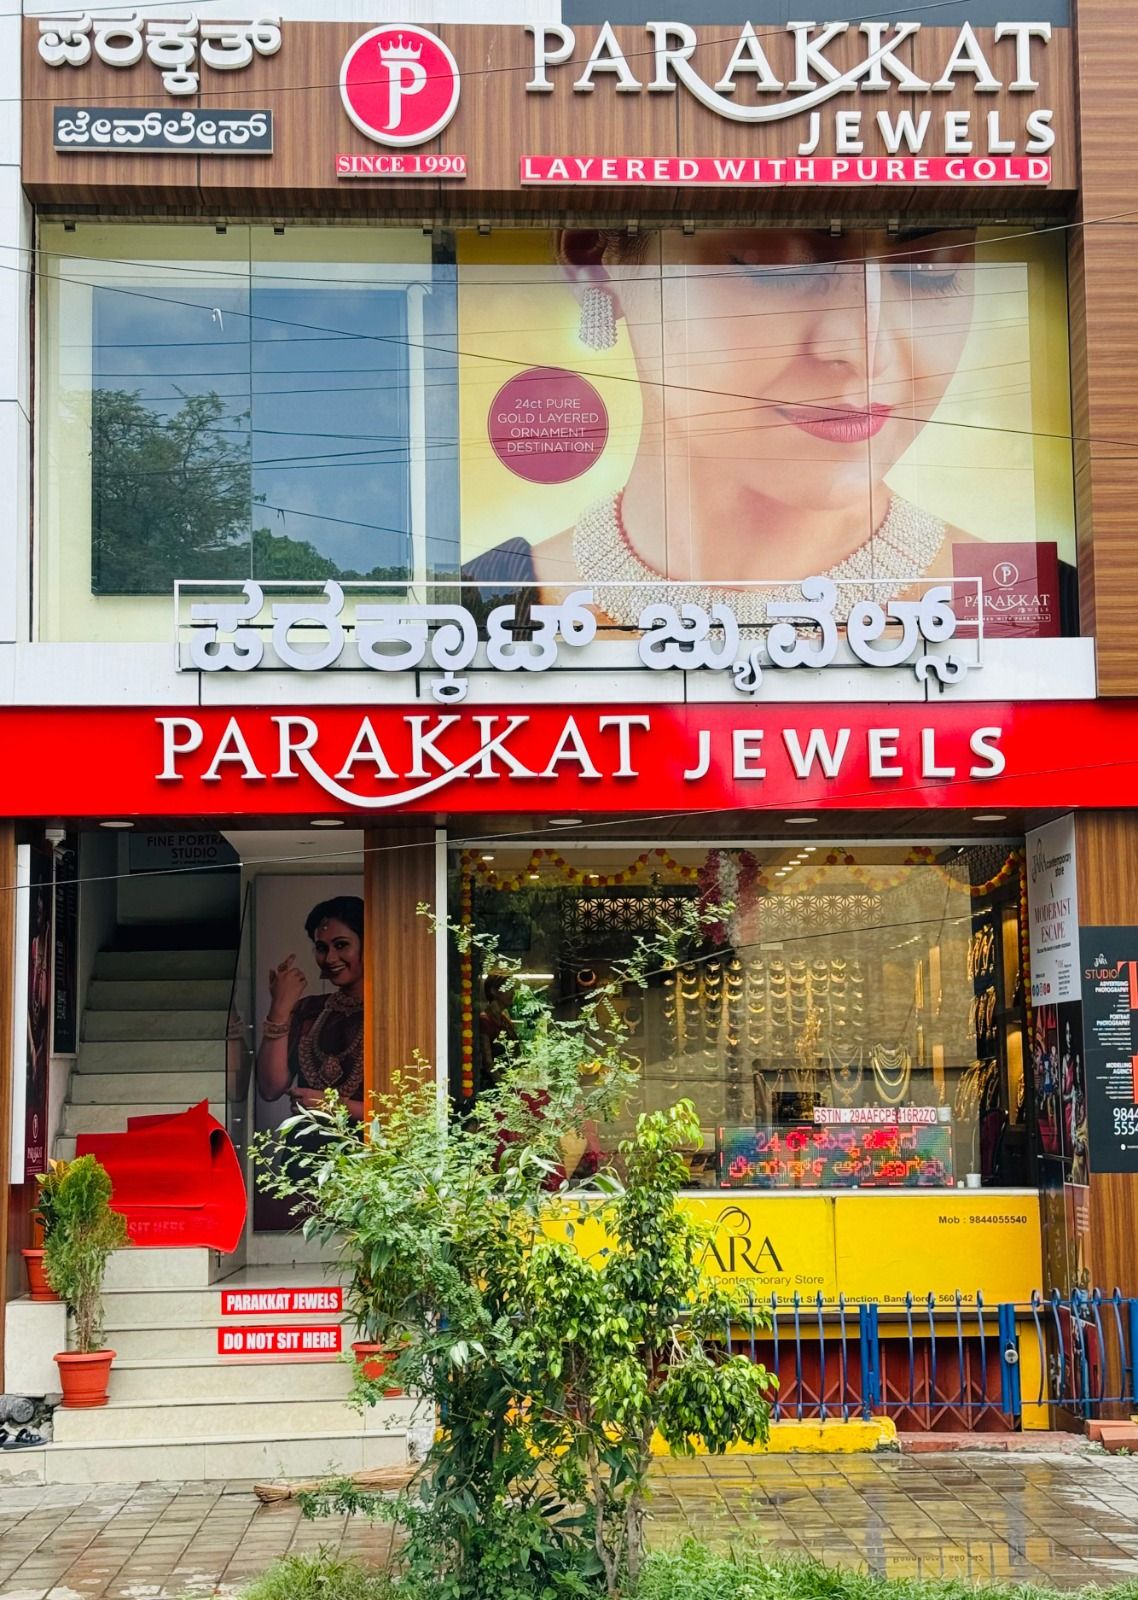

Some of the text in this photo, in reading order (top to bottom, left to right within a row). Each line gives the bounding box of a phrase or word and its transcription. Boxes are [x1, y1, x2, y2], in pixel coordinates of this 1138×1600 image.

[524, 21, 1052, 122] PARAKKAT
[798, 110, 1056, 155] JEWELS
[338, 156, 465, 172] SINCE 1990
[524, 158, 1049, 180] LAYERED WITH PURE GOLD
[515, 398, 581, 409] 24ct PURE
[497, 413, 599, 424] GOLD LAYERED
[510, 427, 586, 438] ORNAMENT
[507, 442, 594, 452] DESTINATION
[964, 594, 1050, 611] PARAKKAT
[154, 714, 1006, 808] PARAKKAT JEWELS
[147, 834, 228, 847] FINE PORTRA
[171, 847, 217, 858] STUDIO
[1034, 898, 1071, 923] MODERNIST
[1041, 921, 1066, 943] ESCAPE
[1085, 969, 1118, 979] STUDIO
[814, 1109, 841, 1122] GSTIN
[938, 1216, 960, 1224] Mob
[969, 1216, 1027, 1224] 9844055540
[795, 1274, 825, 1285] Store
[226, 1292, 339, 1311] PARAKKAT JEWELS
[777, 1295, 804, 1304] Stret
[806, 1295, 835, 1304] Sinal
[840, 1294, 881, 1304] unction,
[884, 1294, 931, 1305] Banglor
[939, 1294, 954, 1302] 560
[223, 1332, 337, 1350] DO NOT SIT HERE
